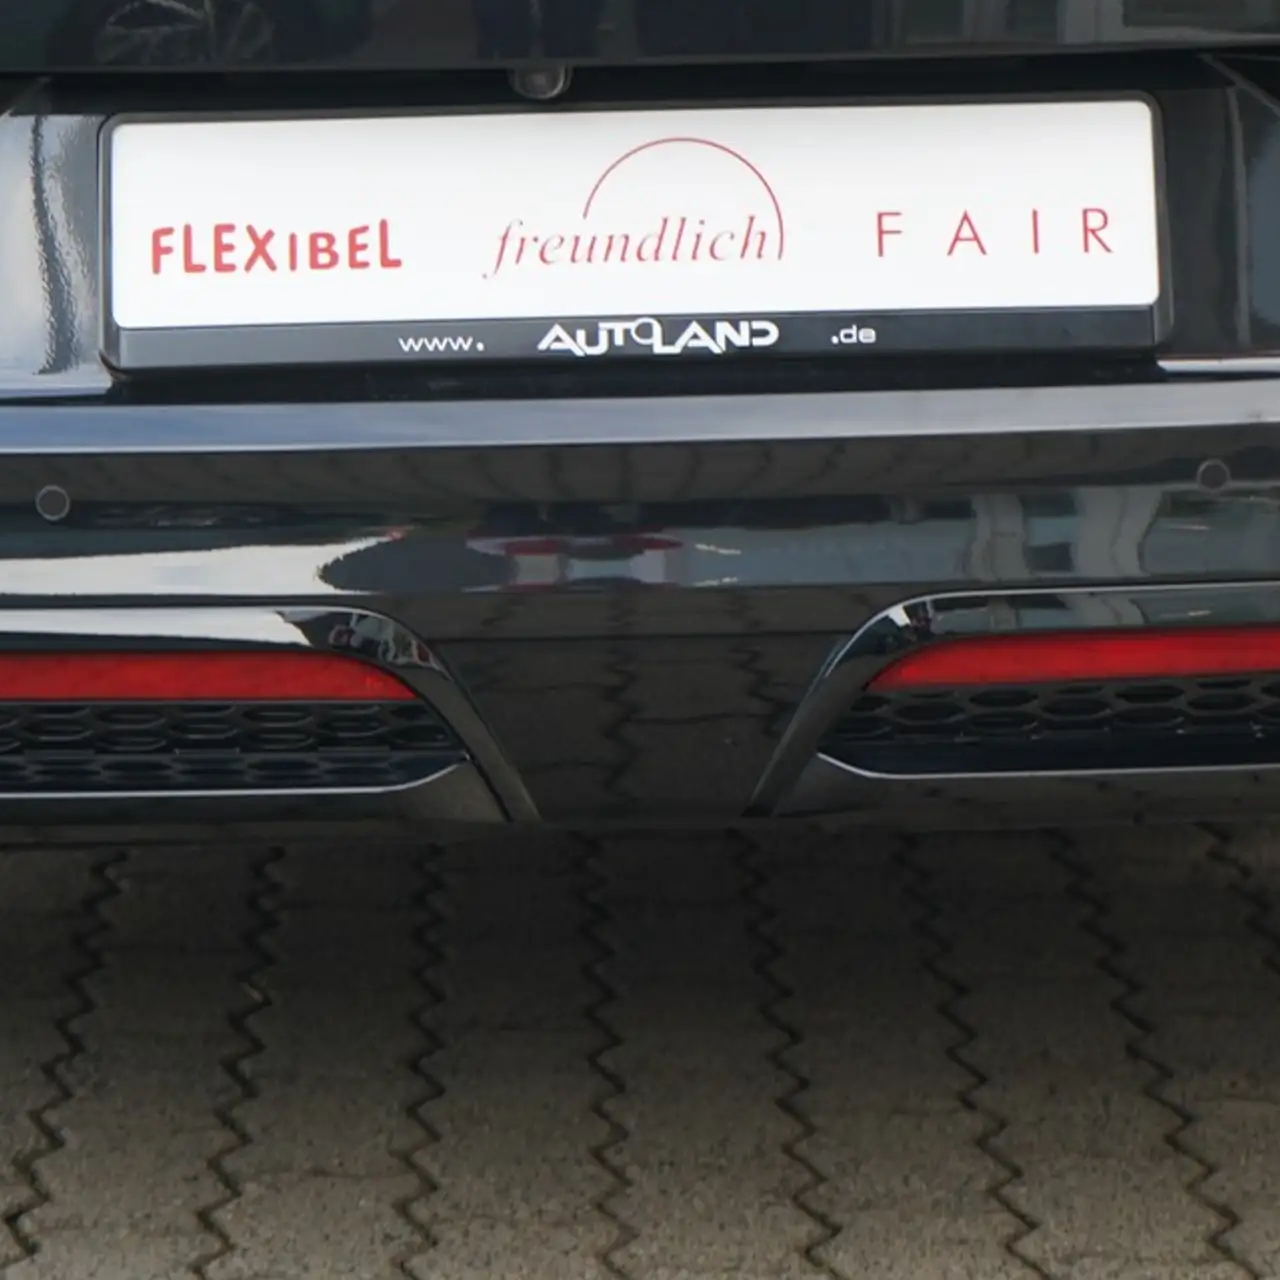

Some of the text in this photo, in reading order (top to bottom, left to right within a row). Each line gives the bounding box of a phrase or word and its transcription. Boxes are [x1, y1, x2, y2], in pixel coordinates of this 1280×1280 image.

[151, 208, 1114, 280] FLEXIBEL freundlich FAIR
[398, 316, 877, 357] www. AUTOLAND .de
